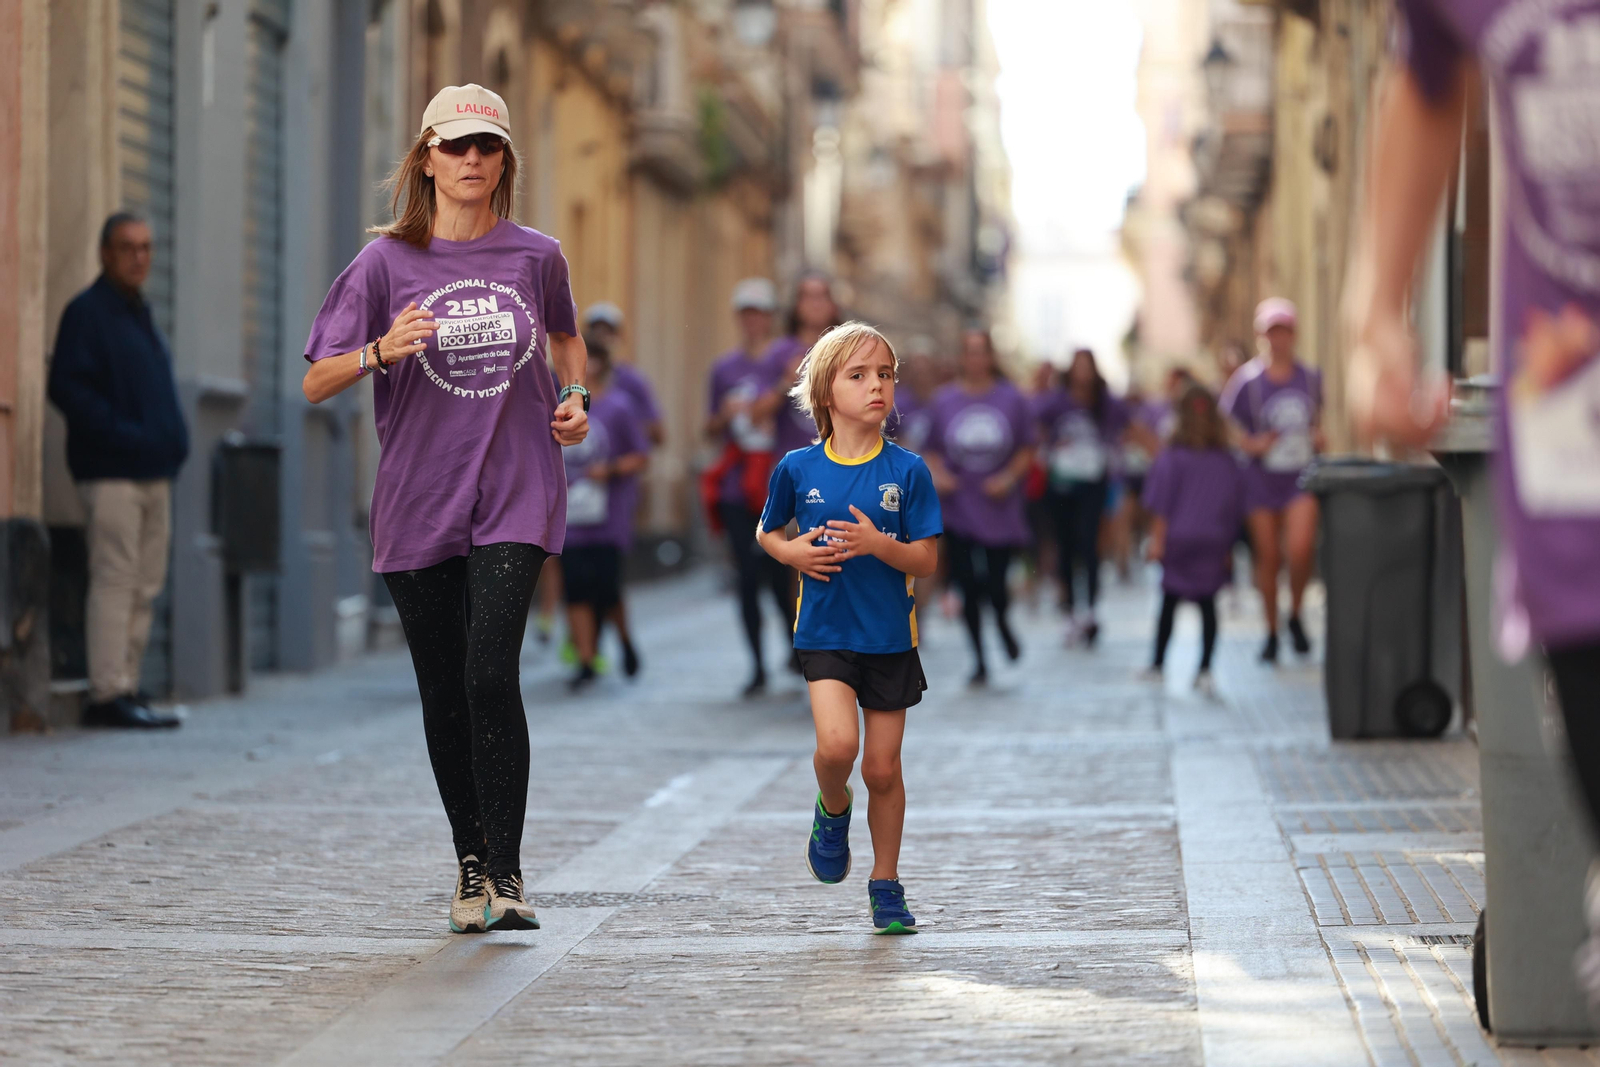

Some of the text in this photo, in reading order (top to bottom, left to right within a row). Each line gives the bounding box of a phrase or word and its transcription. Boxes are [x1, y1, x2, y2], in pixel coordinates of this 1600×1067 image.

[456, 103, 499, 120] LALIGA
[420, 279, 487, 311] TERNACIONAL
[489, 282, 527, 310] CONTRA
[445, 295, 499, 316] 25N
[471, 313, 510, 322] EMERGENCIAS
[525, 310, 535, 325] LA
[447, 320, 502, 334] 24 HORAS
[441, 330, 511, 347] 900 21 21 30
[458, 352, 489, 363] Ayuntamiento
[496, 349, 511, 357] Cádiz
[416, 350, 453, 392] MUJERES
[453, 386, 474, 399] LAS
[477, 379, 511, 399] HACIA
